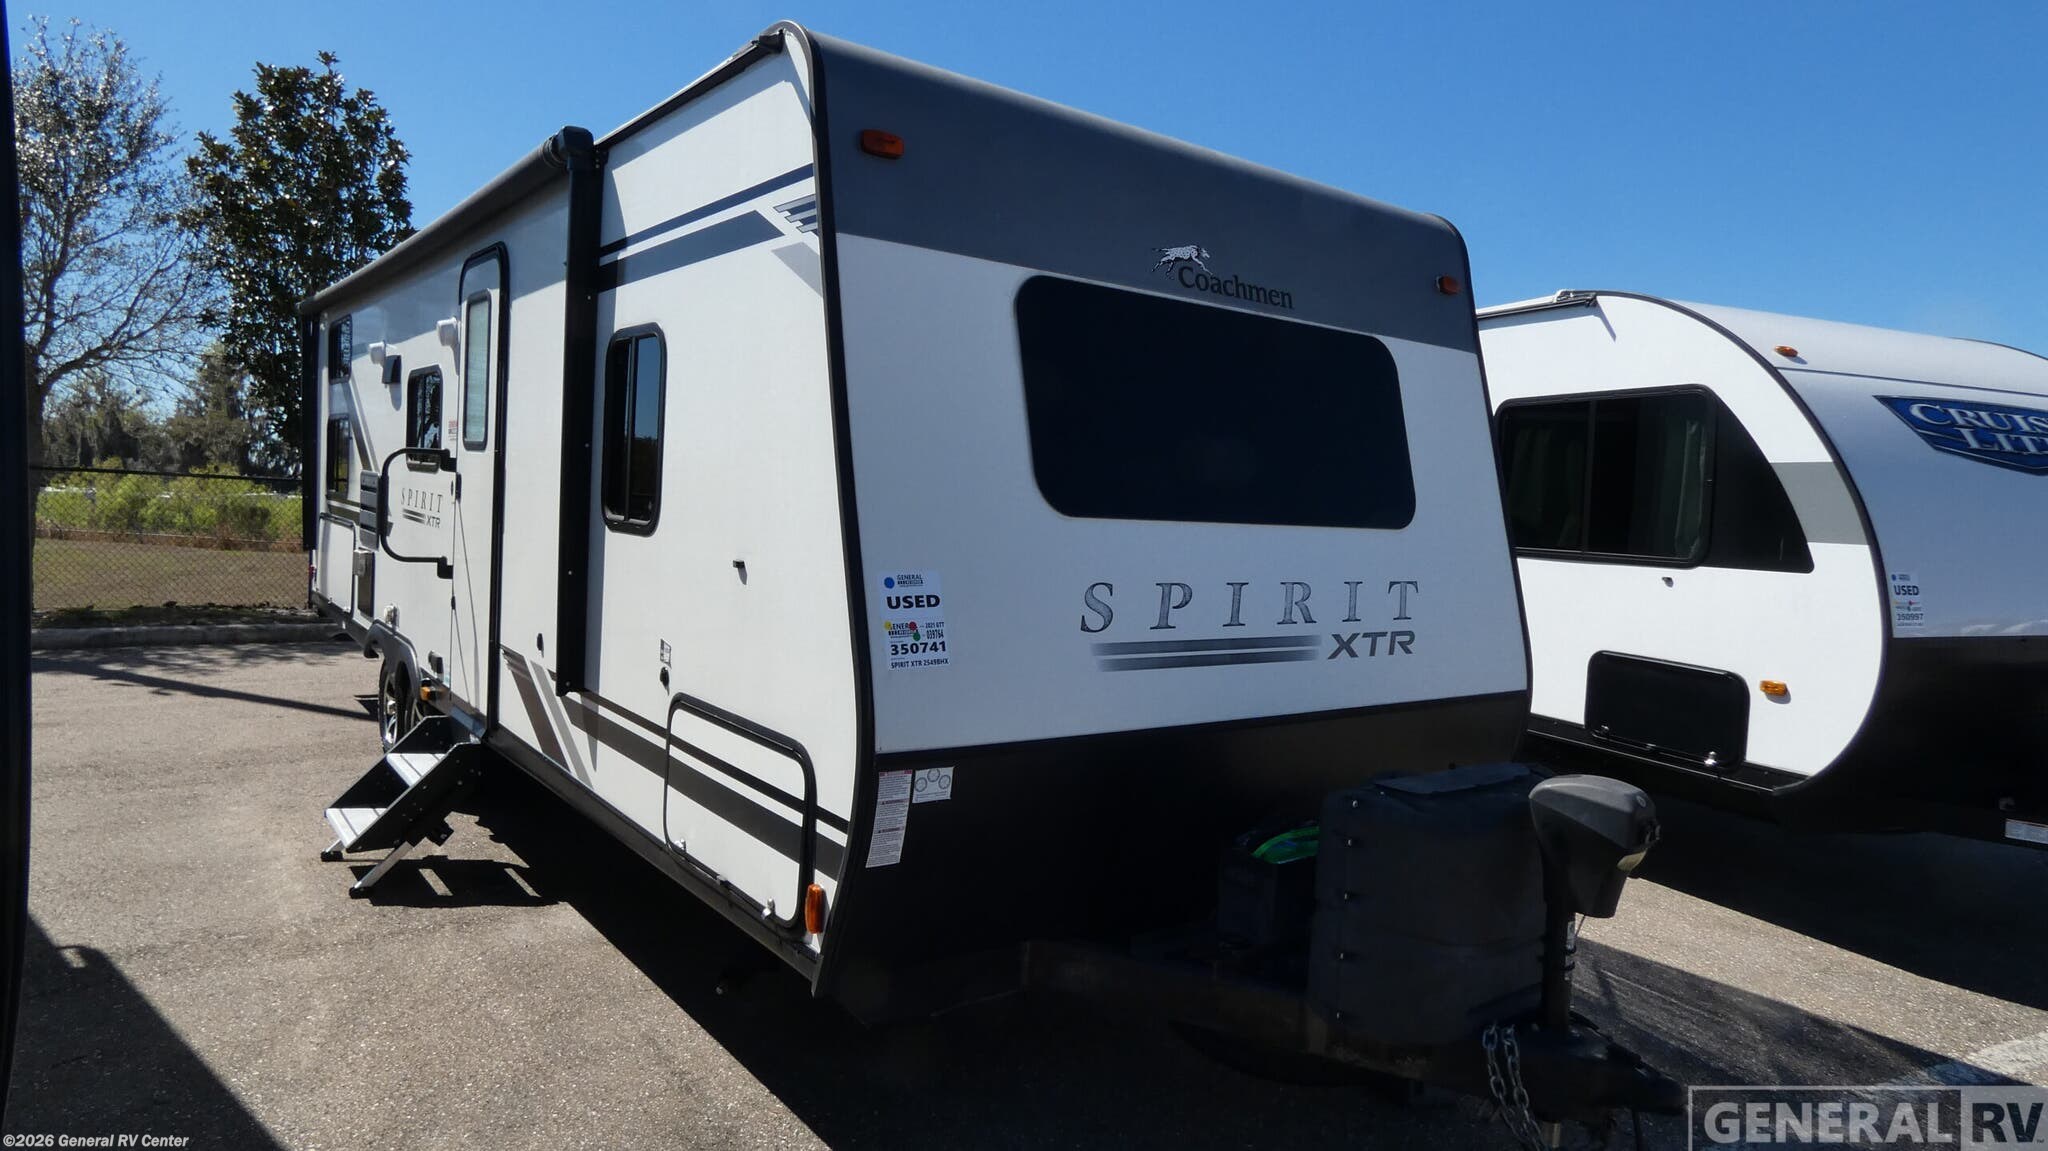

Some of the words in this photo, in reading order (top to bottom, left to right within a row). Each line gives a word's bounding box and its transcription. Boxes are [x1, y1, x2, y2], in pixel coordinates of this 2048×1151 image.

[1178, 265, 1293, 309] Coachmen
[401, 487, 443, 513] SPIRIT
[426, 515, 441, 528] XTR
[1894, 585, 1920, 596] USED
[886, 594, 941, 609] USED
[1080, 580, 1419, 633] SPIRIT
[890, 640, 946, 656] 350741
[1327, 630, 1416, 660] XTR
[890, 660, 909, 669] SPIRIT
